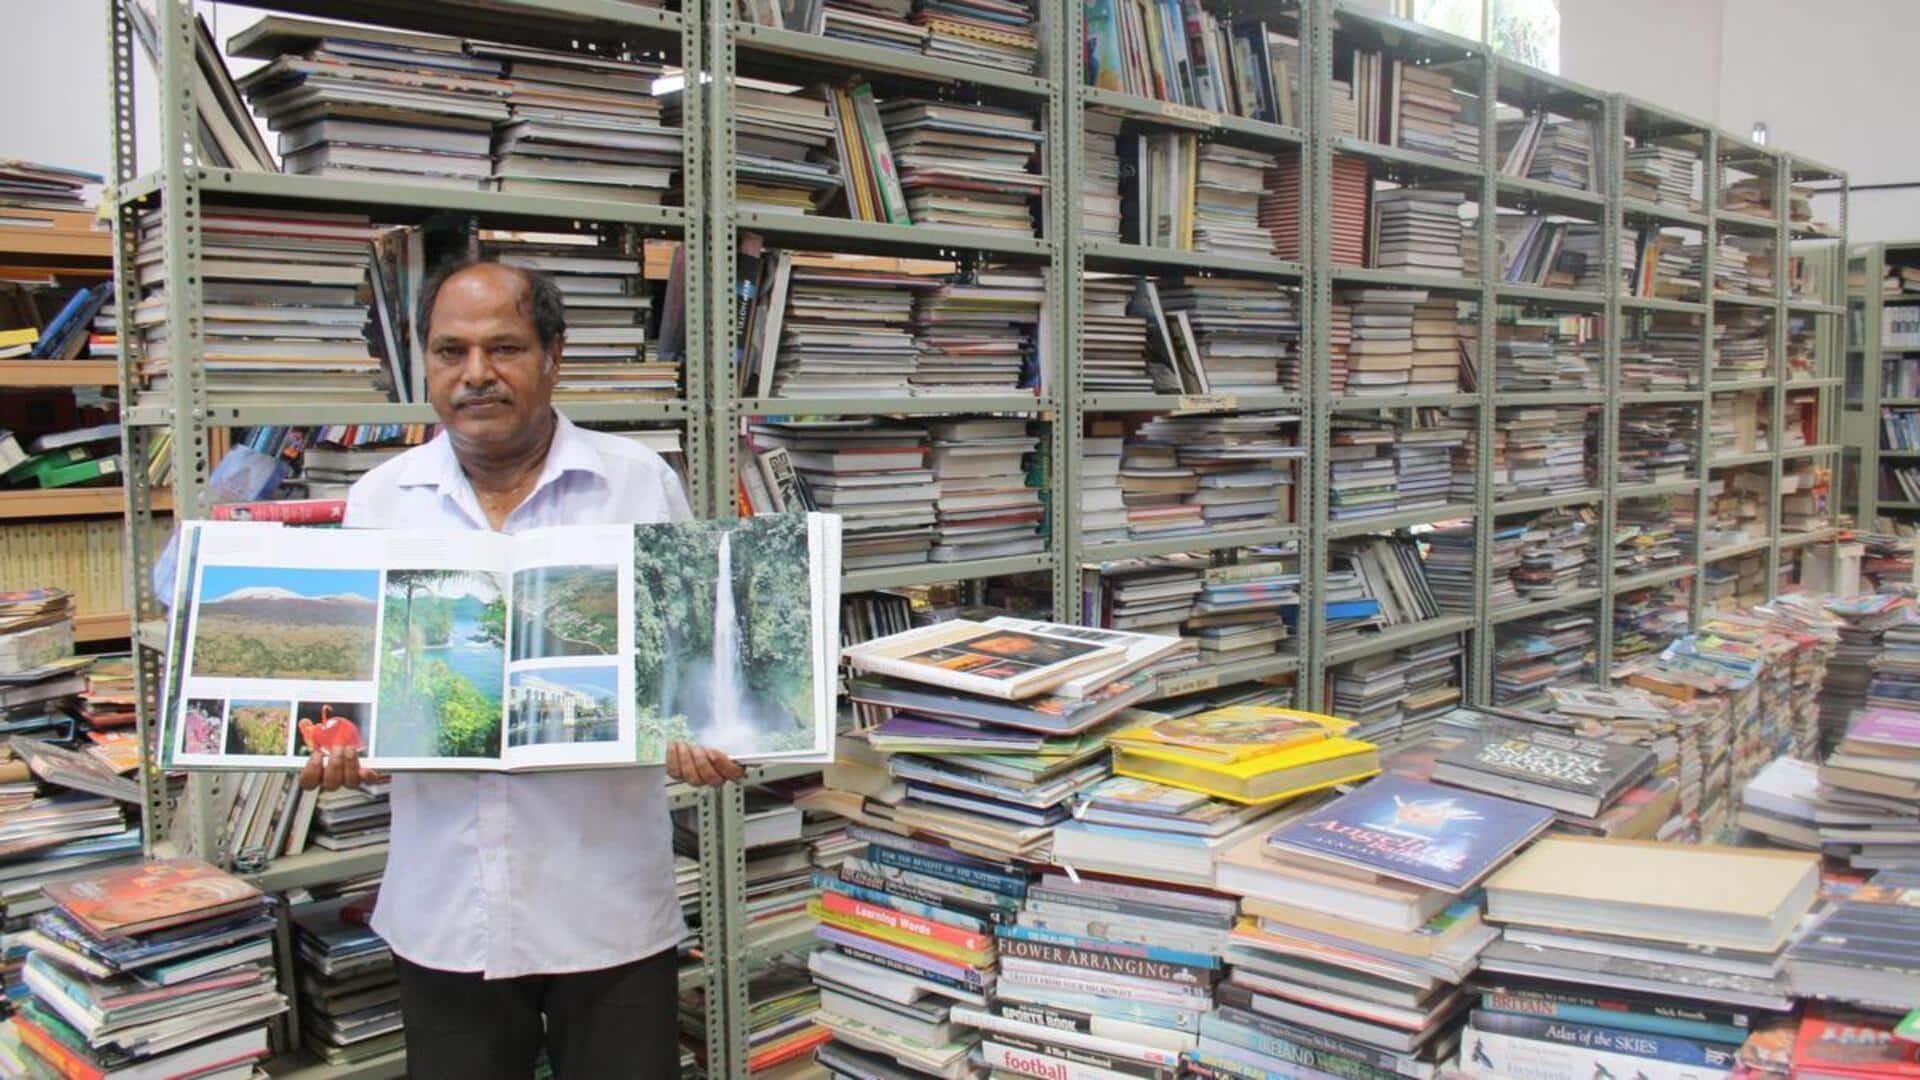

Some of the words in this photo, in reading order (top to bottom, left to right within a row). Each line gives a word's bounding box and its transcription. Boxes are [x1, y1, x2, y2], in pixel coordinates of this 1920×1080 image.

[855, 904, 897, 928] Learning
[899, 915, 931, 936] Words
[997, 937, 1063, 963] FLOWER
[1067, 948, 1171, 980] ARRANGING
[1002, 1006, 1044, 1026] SPORTS
[1045, 1014, 1077, 1032] BOOK
[1491, 992, 1556, 1017] BRITAIN
[1545, 1024, 1577, 1040] Atlas
[1578, 1028, 1592, 1046] of
[1594, 1031, 1612, 1046] the
[1615, 1036, 1658, 1054] SKIES
[1003, 1051, 1068, 1080] football
